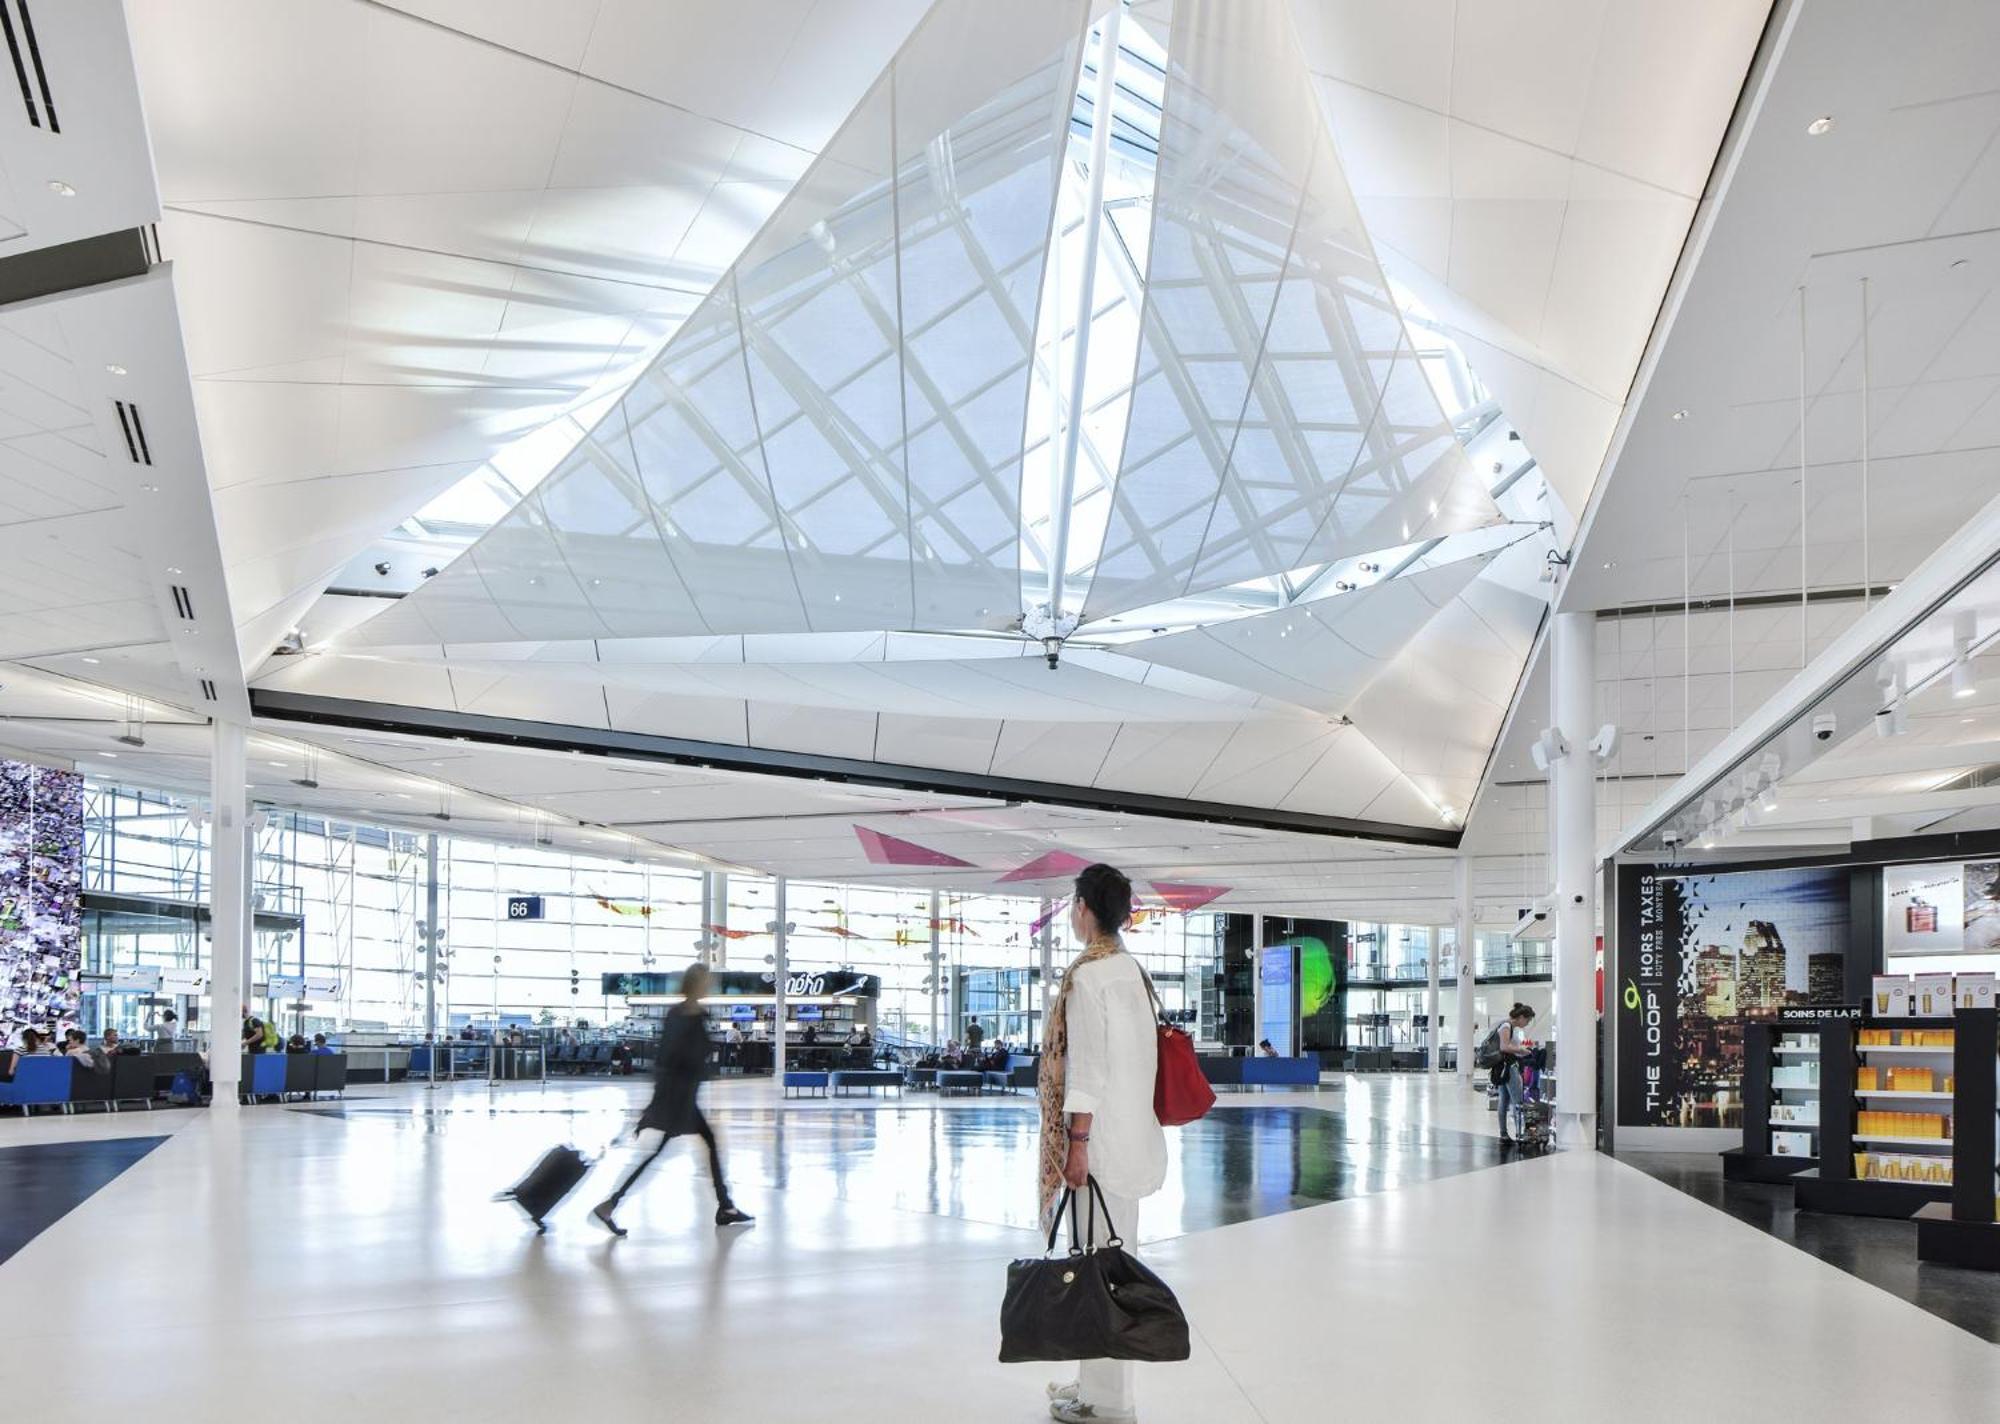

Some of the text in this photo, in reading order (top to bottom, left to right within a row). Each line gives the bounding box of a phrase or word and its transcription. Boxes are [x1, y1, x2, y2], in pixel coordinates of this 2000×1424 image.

[510, 902, 528, 917] 66
[1641, 875, 1654, 977] HORS TAXES
[1655, 953, 1664, 977] DUTY
[1783, 1010, 1816, 1019] SOINS
[1817, 1010, 1833, 1018] DE
[1834, 1010, 1849, 1018] LA
[1646, 993, 1661, 1112] THE LOOP
